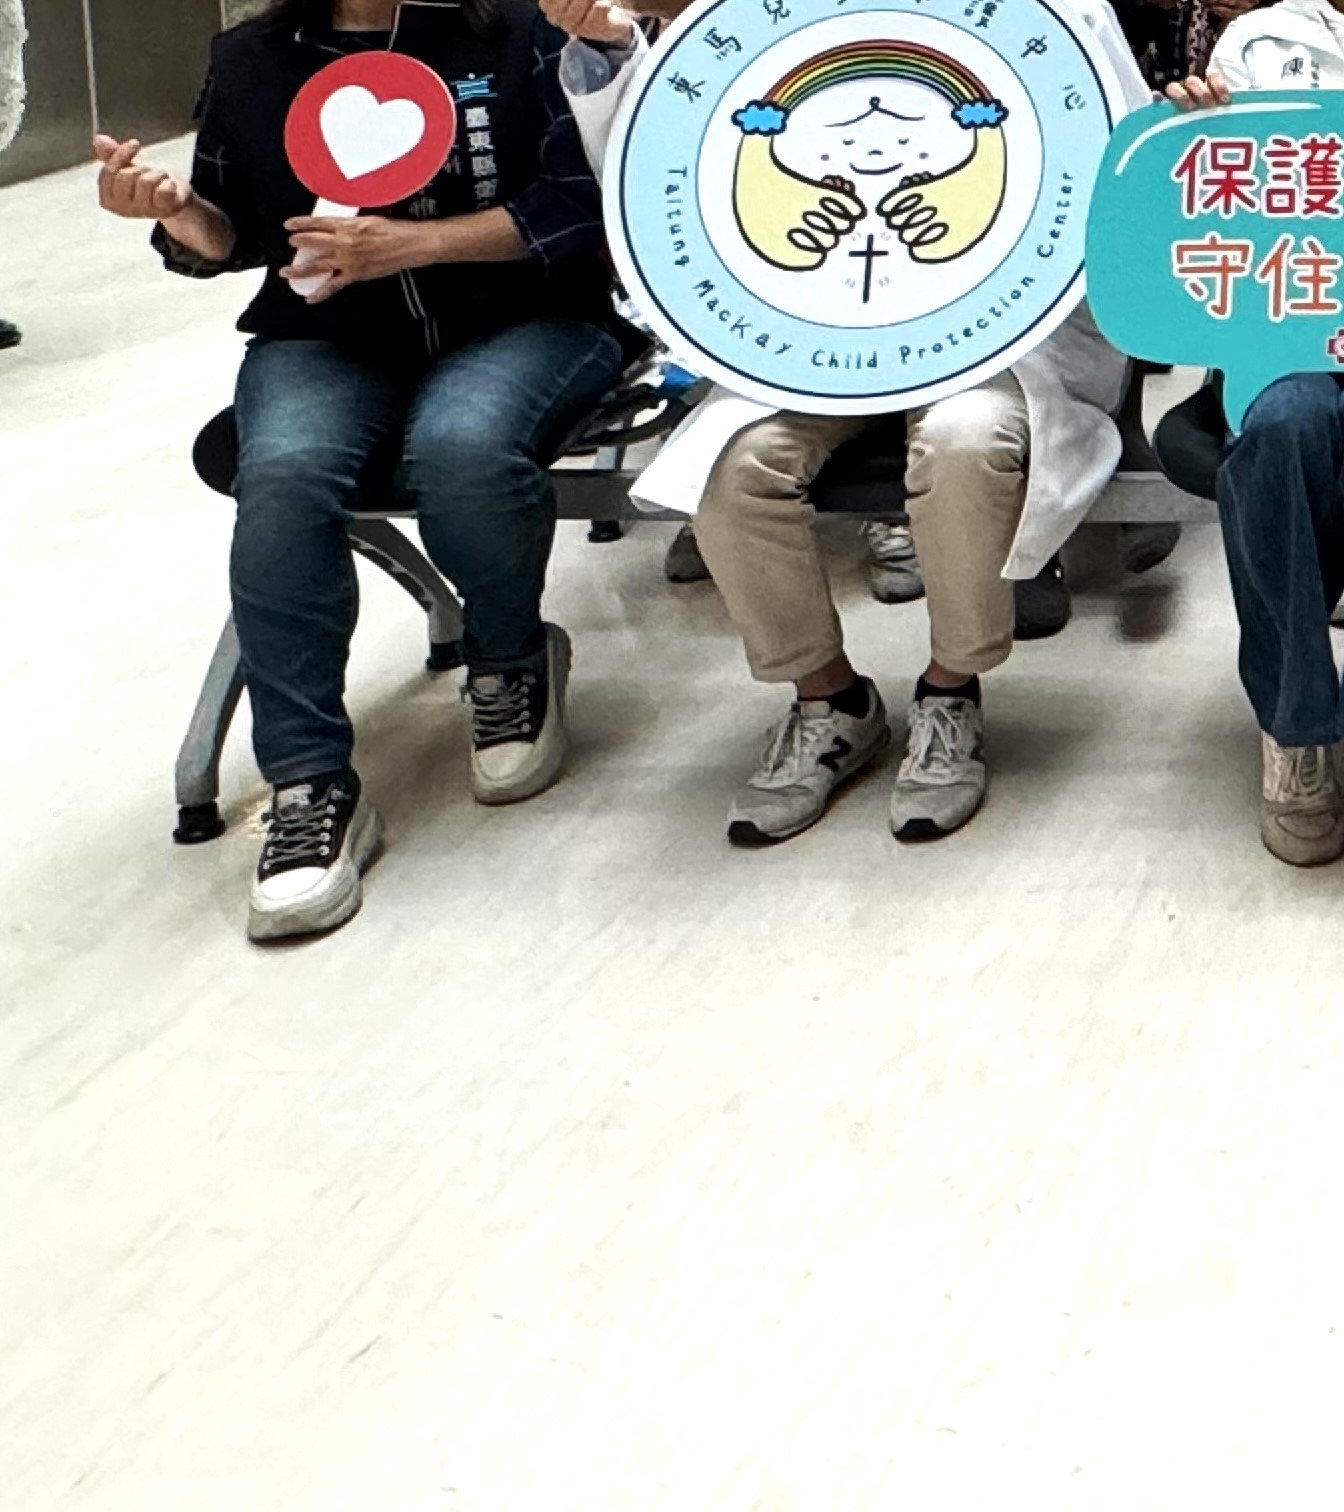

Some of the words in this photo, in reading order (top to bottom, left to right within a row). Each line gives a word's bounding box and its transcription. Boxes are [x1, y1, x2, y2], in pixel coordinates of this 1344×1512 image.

[664, 165, 690, 269] Taitung
[692, 278, 794, 357] MacKay
[811, 348, 879, 370] Child
[899, 275, 1036, 365] Protection
[1037, 172, 1075, 259] Center
